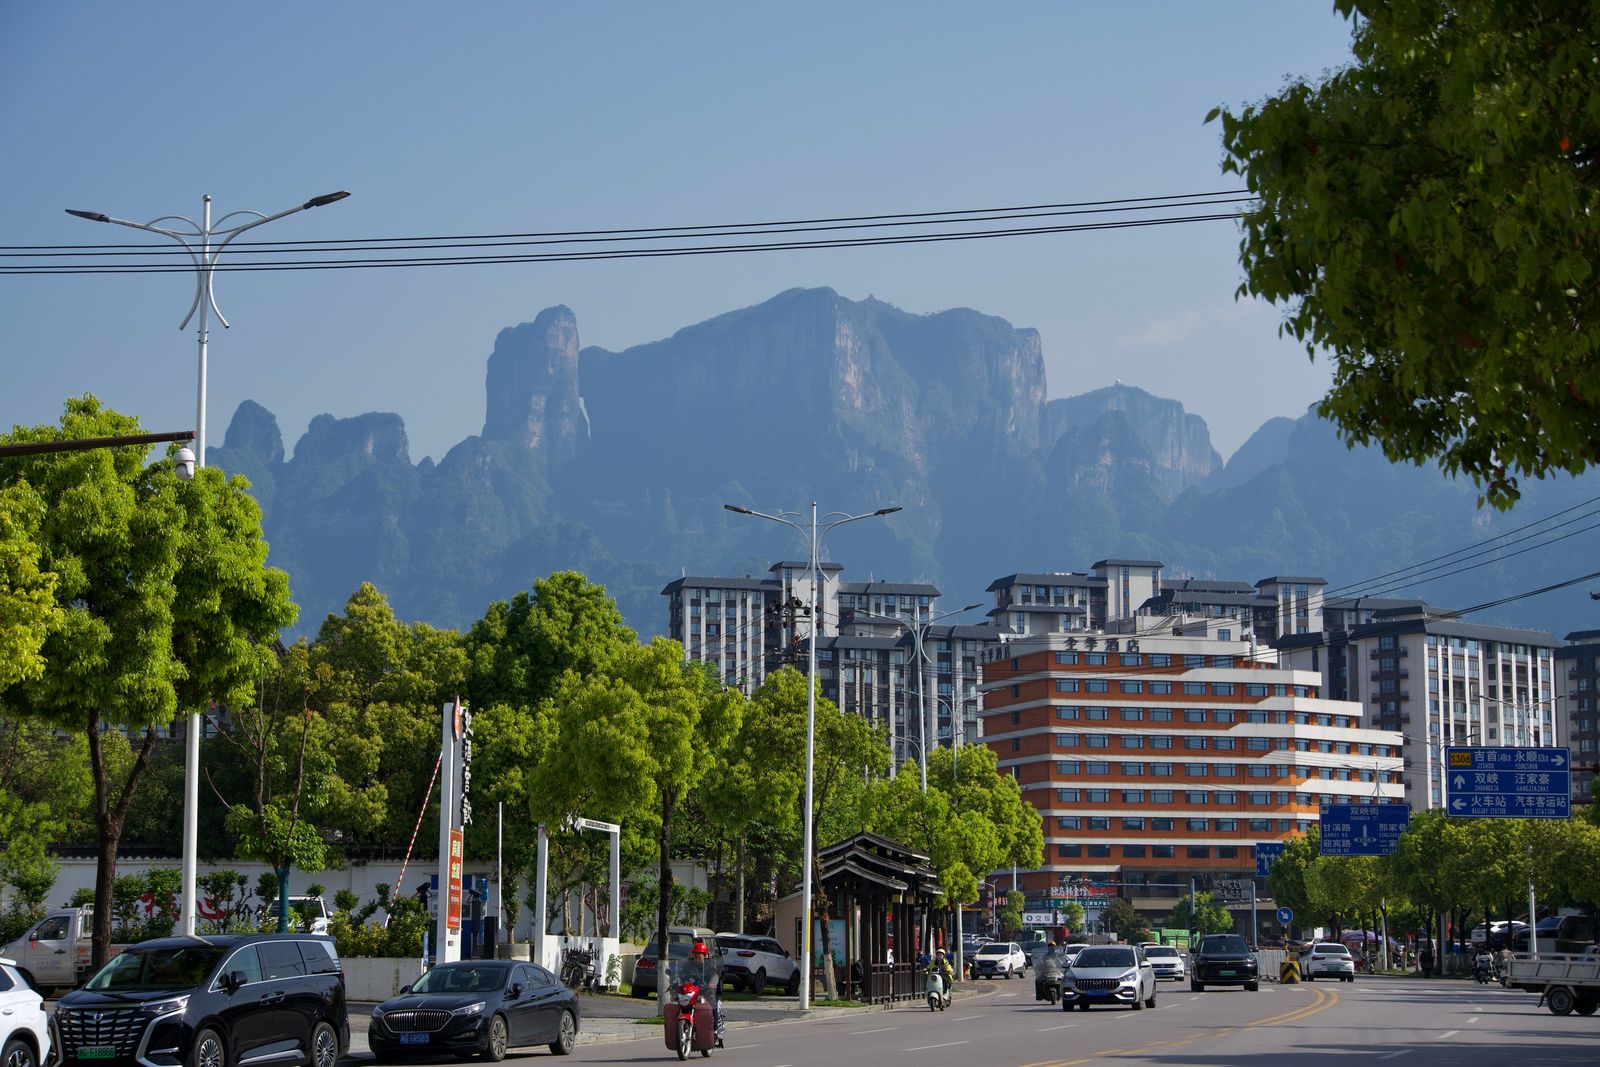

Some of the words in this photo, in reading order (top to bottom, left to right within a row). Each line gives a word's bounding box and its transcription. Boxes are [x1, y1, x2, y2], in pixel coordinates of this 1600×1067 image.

[1064, 636, 1139, 653] 全季酒店
[1450, 753, 1471, 765] S306
[1474, 750, 1498, 762] 吉首
[1514, 751, 1538, 762] 永顺
[1474, 773, 1499, 784] 双峡
[1515, 773, 1550, 785] 汪家寨
[1470, 795, 1507, 807] 火车站
[1515, 795, 1566, 808] 汽车客运站
[1350, 806, 1379, 815] 双峡街
[1323, 823, 1351, 832] 甘溪路
